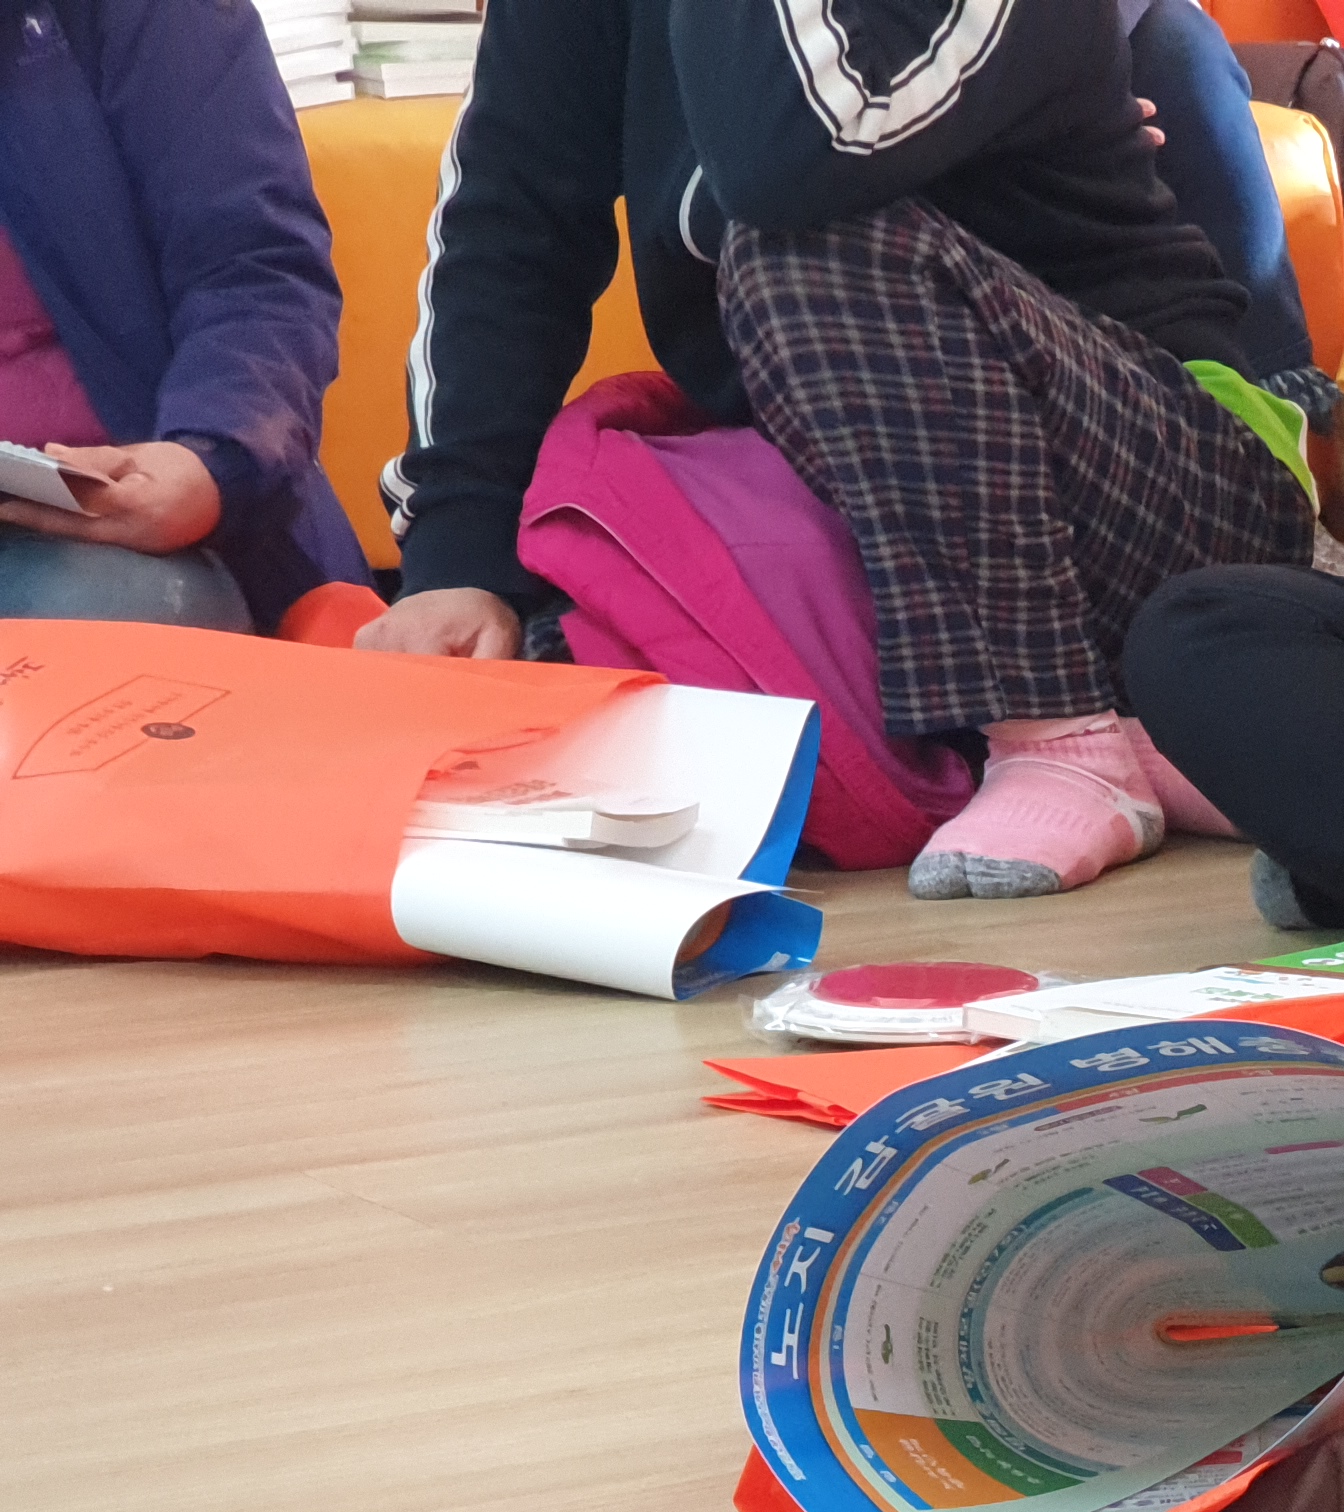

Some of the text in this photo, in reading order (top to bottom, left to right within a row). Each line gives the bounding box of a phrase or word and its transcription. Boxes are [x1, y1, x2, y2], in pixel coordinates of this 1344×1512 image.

[770, 1226, 835, 1380] 노지
[835, 1073, 1052, 1196] 감귤원
[1069, 1035, 1311, 1073] 병해충
